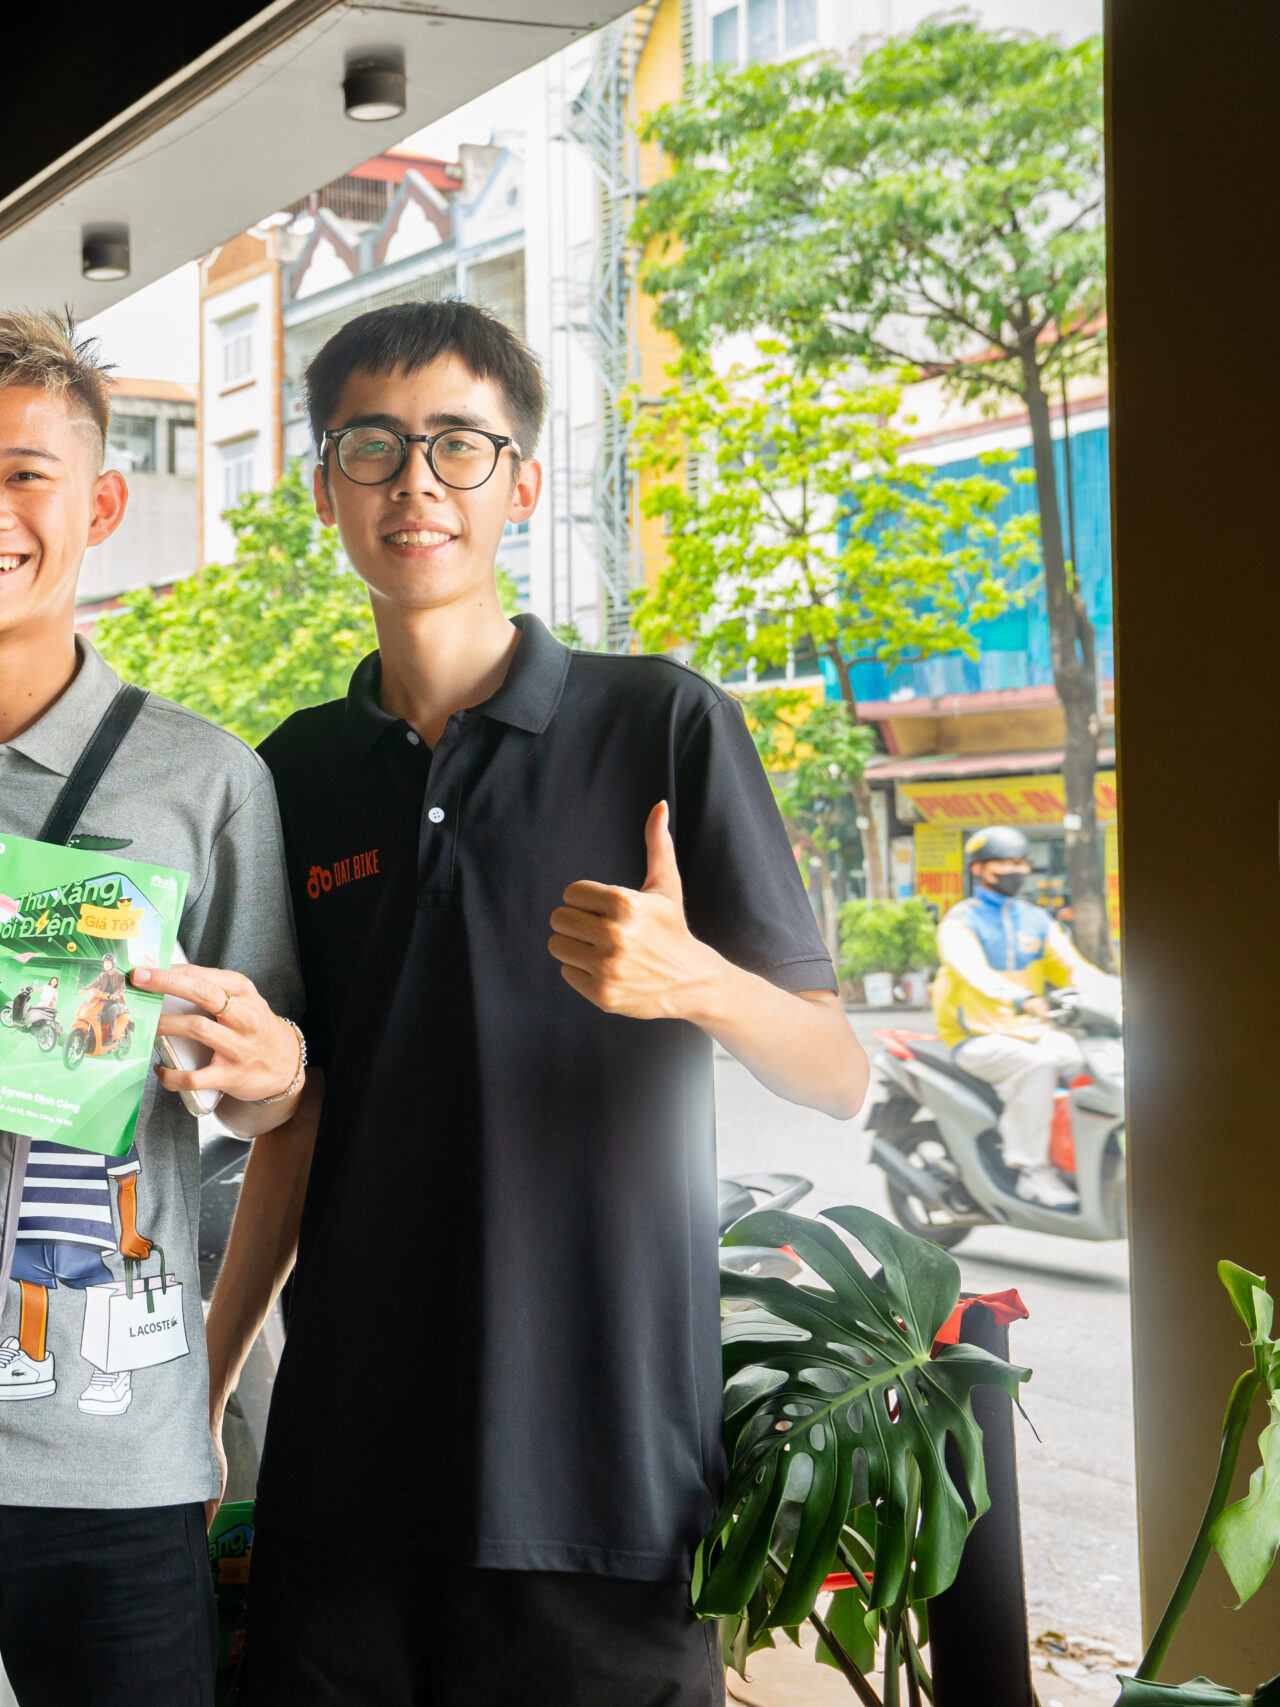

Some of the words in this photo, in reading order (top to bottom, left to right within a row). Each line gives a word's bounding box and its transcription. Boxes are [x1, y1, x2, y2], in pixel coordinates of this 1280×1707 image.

[333, 849, 380, 887] DAT.BIKE
[18, 892, 51, 912] Thu
[52, 878, 121, 907] Xăng
[85, 915, 107, 930] Giá
[129, 1319, 170, 1338] LACOSTE
[208, 1529, 245, 1560] ăng
